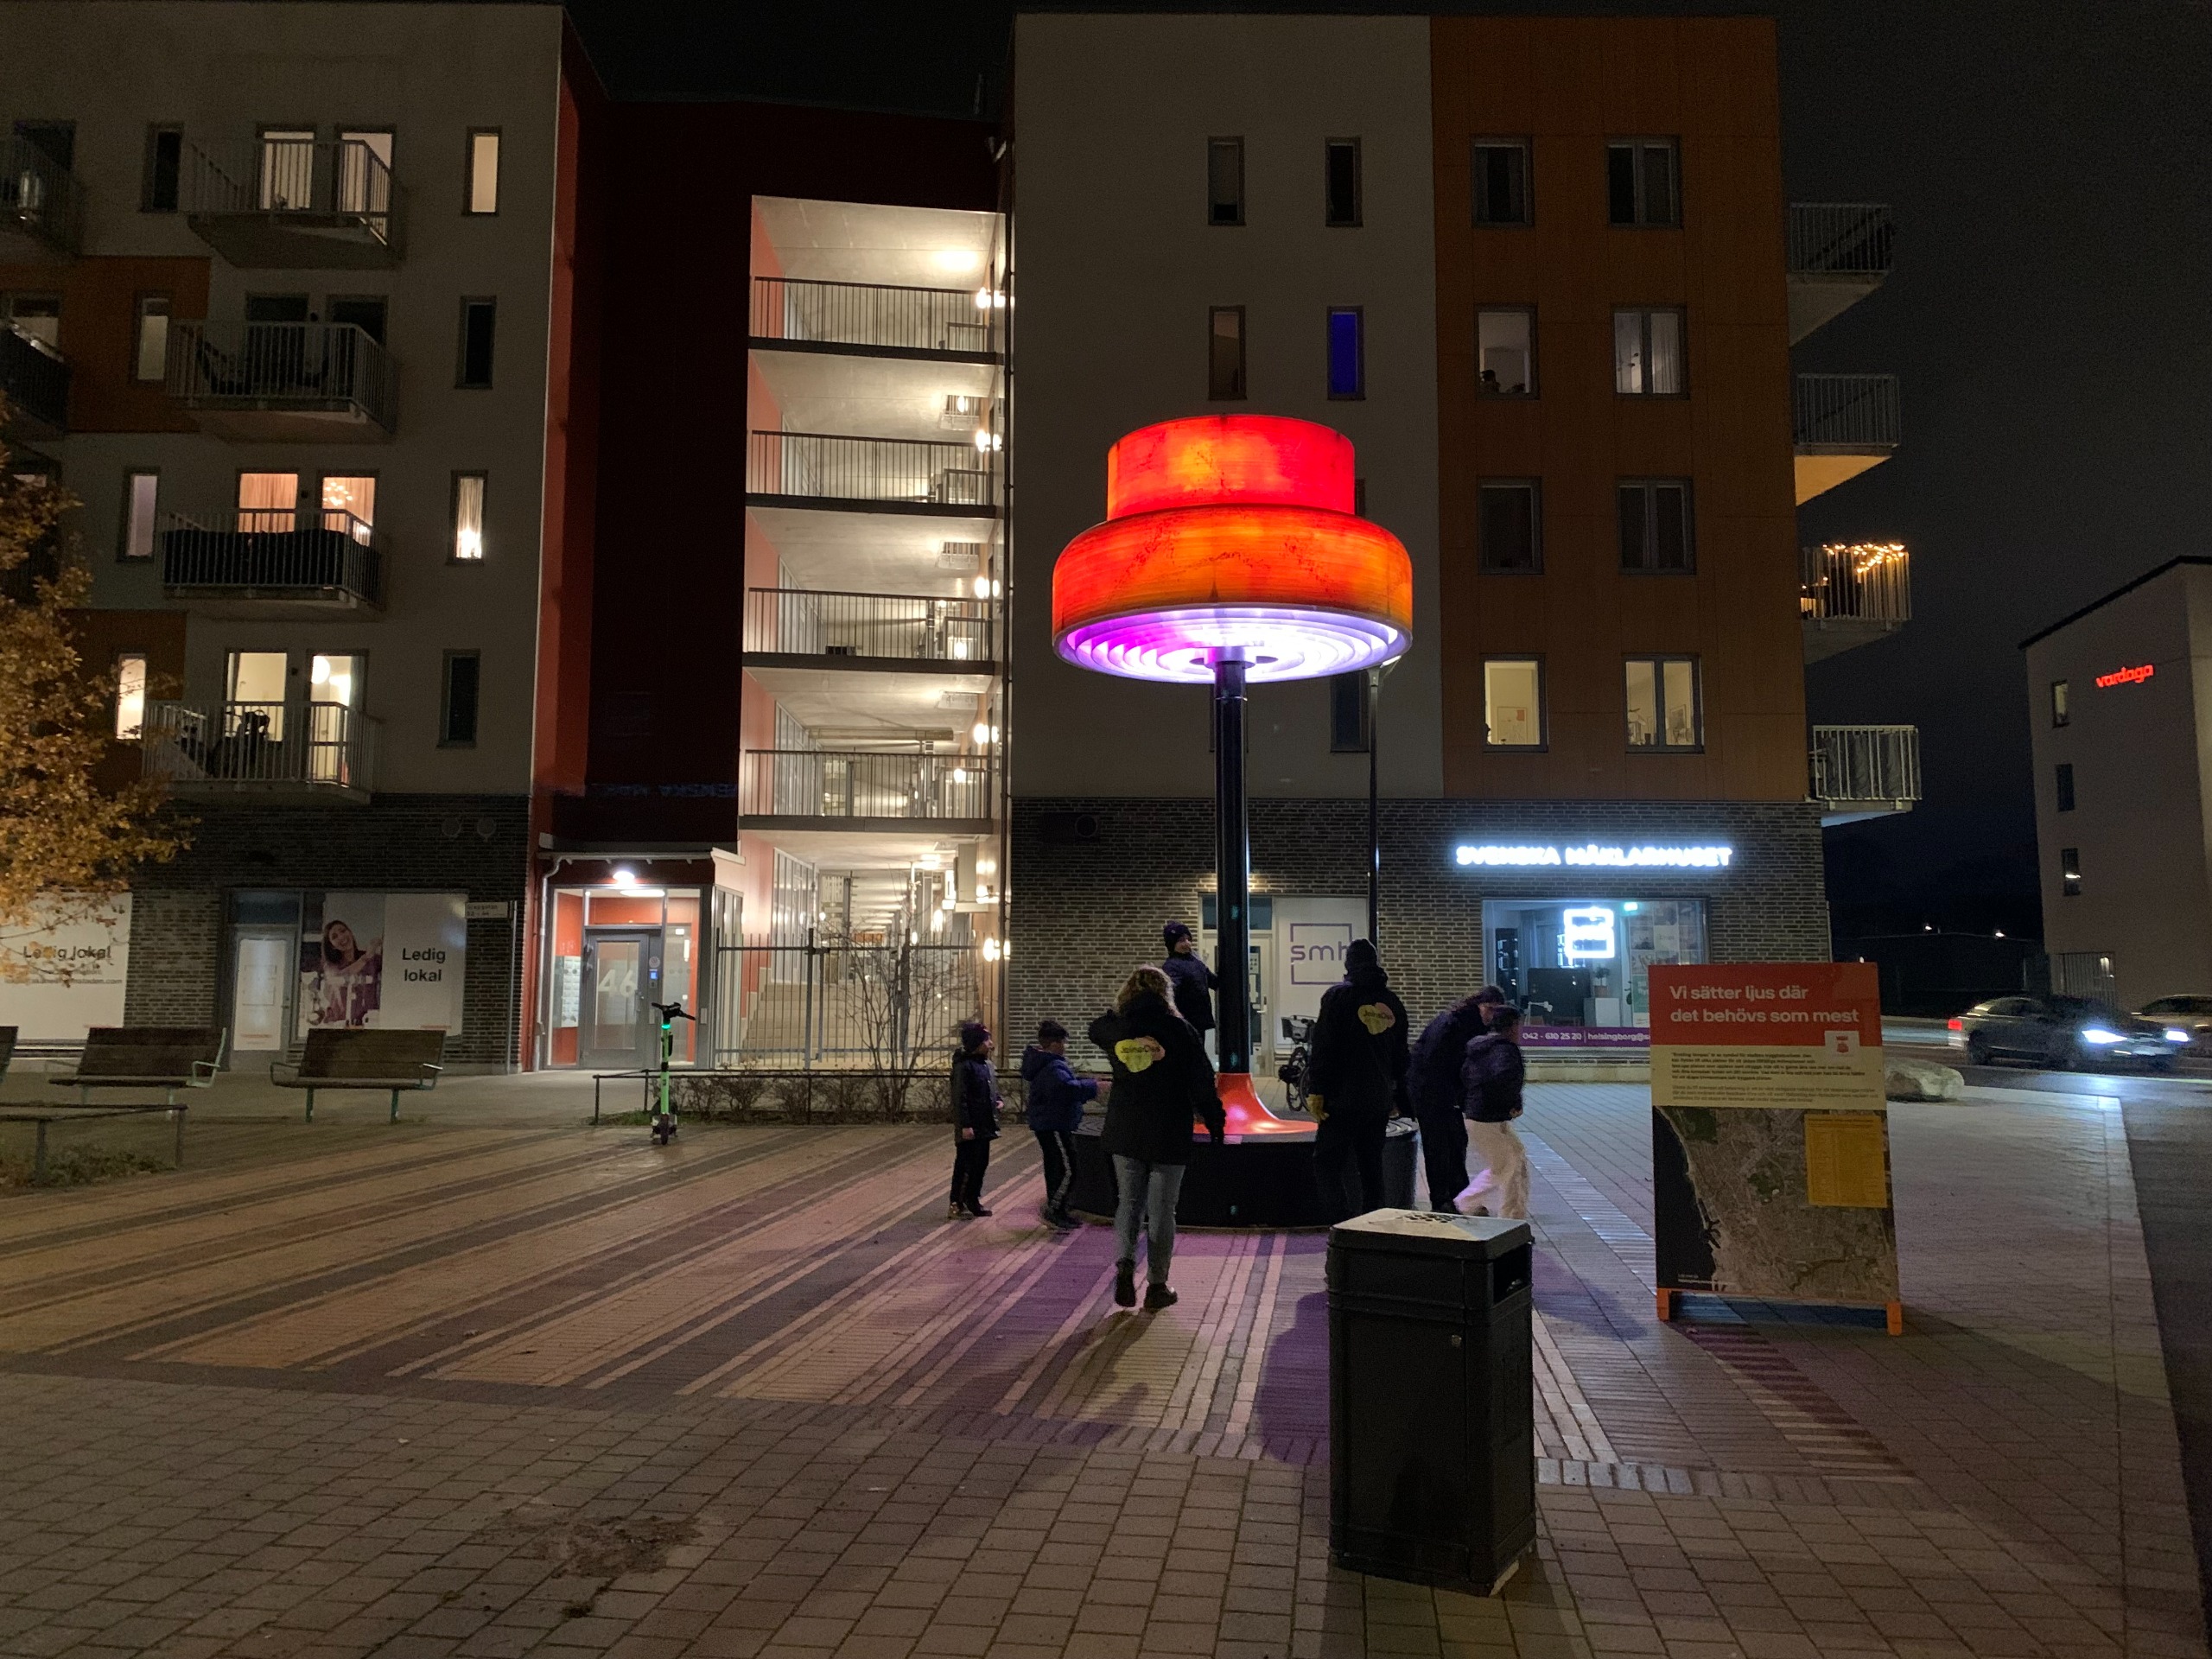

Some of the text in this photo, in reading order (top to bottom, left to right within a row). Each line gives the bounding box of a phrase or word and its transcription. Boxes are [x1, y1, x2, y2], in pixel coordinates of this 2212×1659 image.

[2095, 664, 2155, 688] vardaga
[23, 945, 67, 960] Leig
[402, 947, 446, 963] Ledig
[404, 969, 442, 982] lokal
[598, 969, 638, 999] 46
[1669, 985, 1808, 1002] Vi sätter ljus där
[1670, 1008, 1859, 1023] det behövs som mest
[1522, 1032, 1539, 1040] 042
